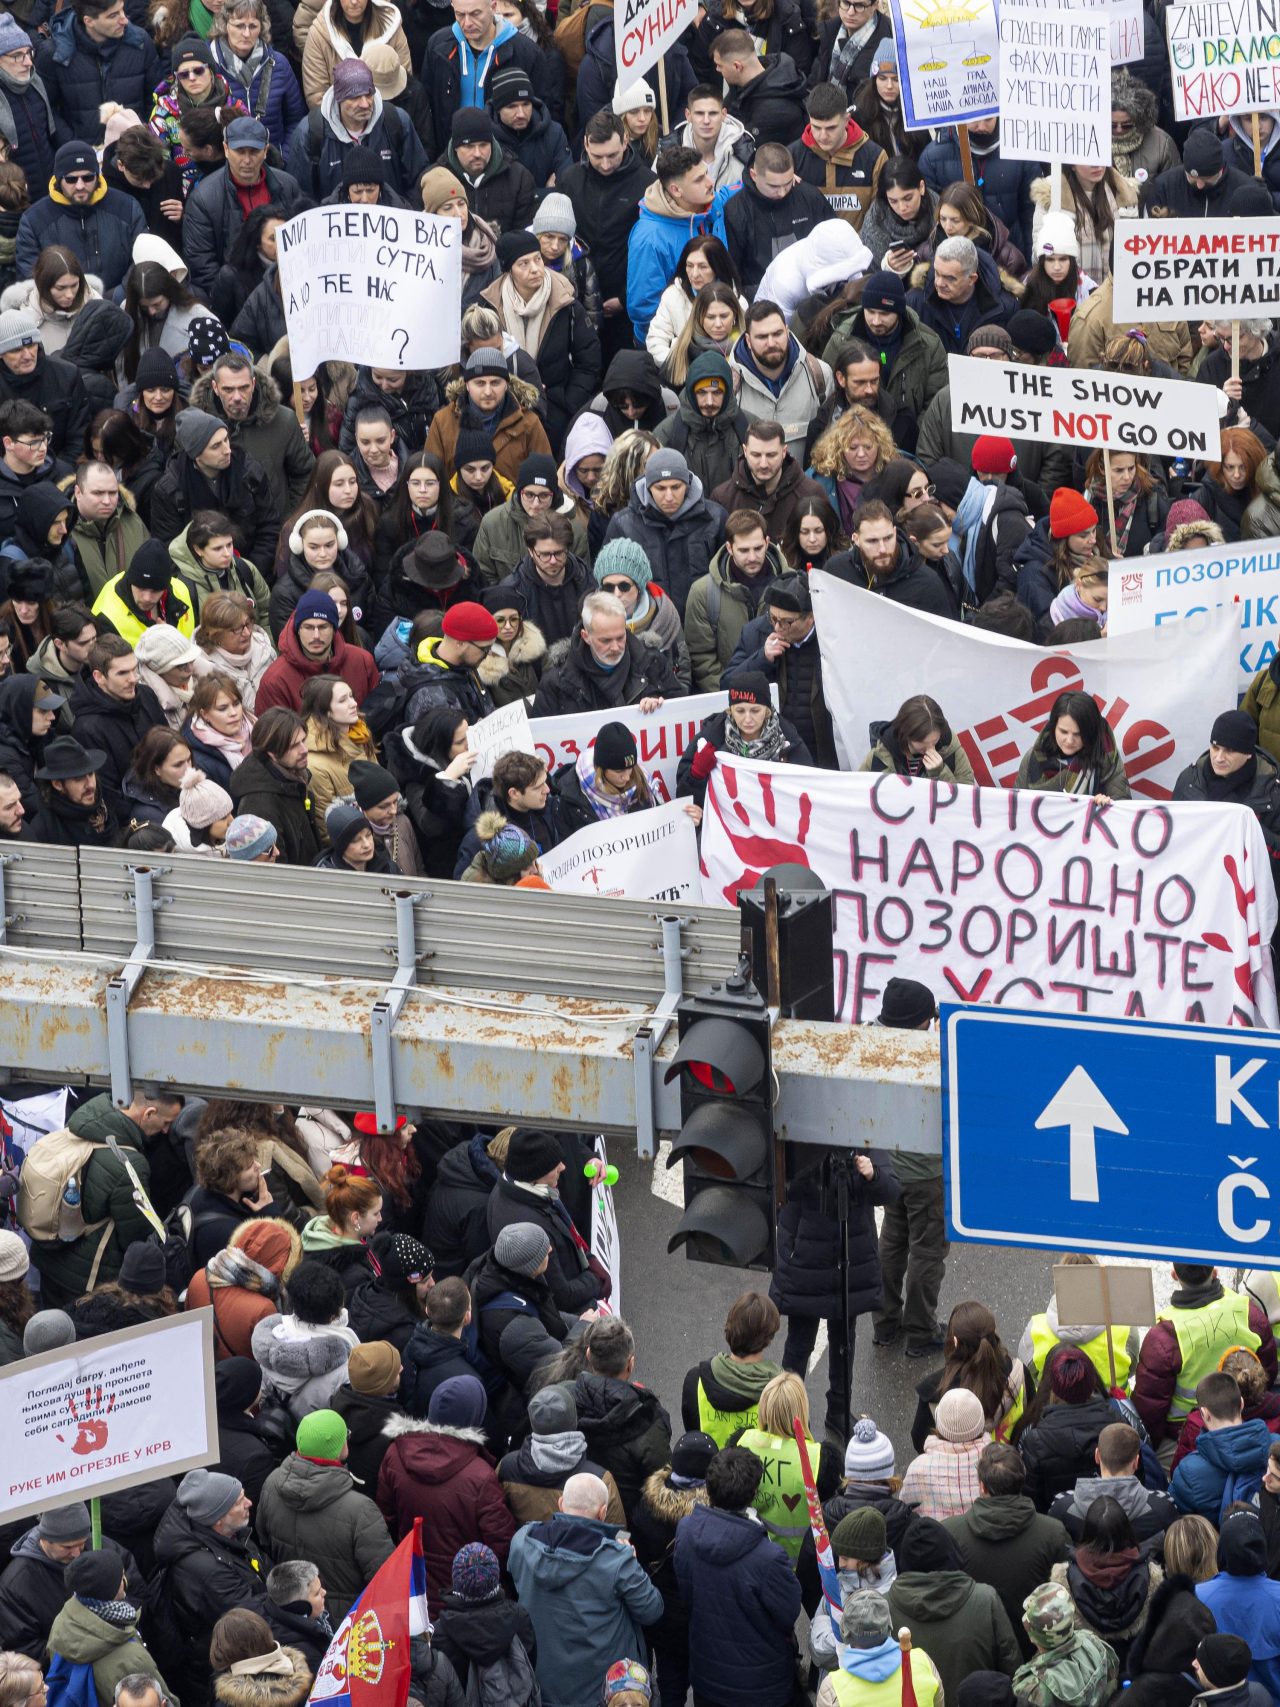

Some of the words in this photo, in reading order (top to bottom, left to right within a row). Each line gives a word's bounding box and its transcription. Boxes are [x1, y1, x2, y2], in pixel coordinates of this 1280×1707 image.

[1000, 18, 1063, 48] СТУДЕНТИ
[1071, 25, 1107, 51] ГЛУМЕ
[1171, 0, 1252, 40] ZAHTEVI
[1009, 49, 1099, 79] ФАКУЛТЕТА
[1006, 78, 1100, 113] УМЕТНОСТИ
[1245, 67, 1270, 104] NE
[1003, 118, 1100, 158] ПРИШТИНА
[282, 218, 307, 252] МИ
[322, 212, 399, 243] ЋЕМО
[415, 218, 451, 248] ВАС
[318, 273, 352, 294] ЋЕ
[367, 275, 398, 302] НАС
[1132, 258, 1240, 280] ОБРАТИ
[1136, 287, 1174, 307] НА
[1003, 370, 1053, 398] THE
[1071, 379, 1163, 409] SHOW
[961, 402, 1042, 433] MUST
[1052, 410, 1112, 442] NOT
[1118, 421, 1157, 446] GO
[1167, 428, 1207, 452] ON
[870, 774, 1173, 859] СРПСКО
[582, 820, 676, 864] ПОЗОРИШТЕ
[850, 828, 1196, 928] НАРОДНО
[833, 888, 1215, 991] ПОЗОРИШТЕ
[1184, 1310, 1243, 1348] ПКГ
[22, 1395, 61, 1414] њихова
[64, 1388, 91, 1402] душа
[105, 1369, 153, 1389] проклета
[27, 1379, 73, 1400] Погледај
[76, 1370, 107, 1386] багру,
[110, 1358, 146, 1376] анђеле
[24, 1424, 49, 1438] себи
[51, 1407, 105, 1431] саградили
[108, 1395, 152, 1413] храмове
[25, 1410, 57, 1425] свима
[60, 1405, 70, 1416] су
[118, 1382, 151, 1397] амове
[9, 1477, 42, 1495] РУКЕ
[46, 1470, 66, 1484] ИМ
[70, 1452, 130, 1477] ОГРЕЗЛЕ
[133, 1449, 142, 1460] У
[146, 1440, 172, 1456] КРВ
